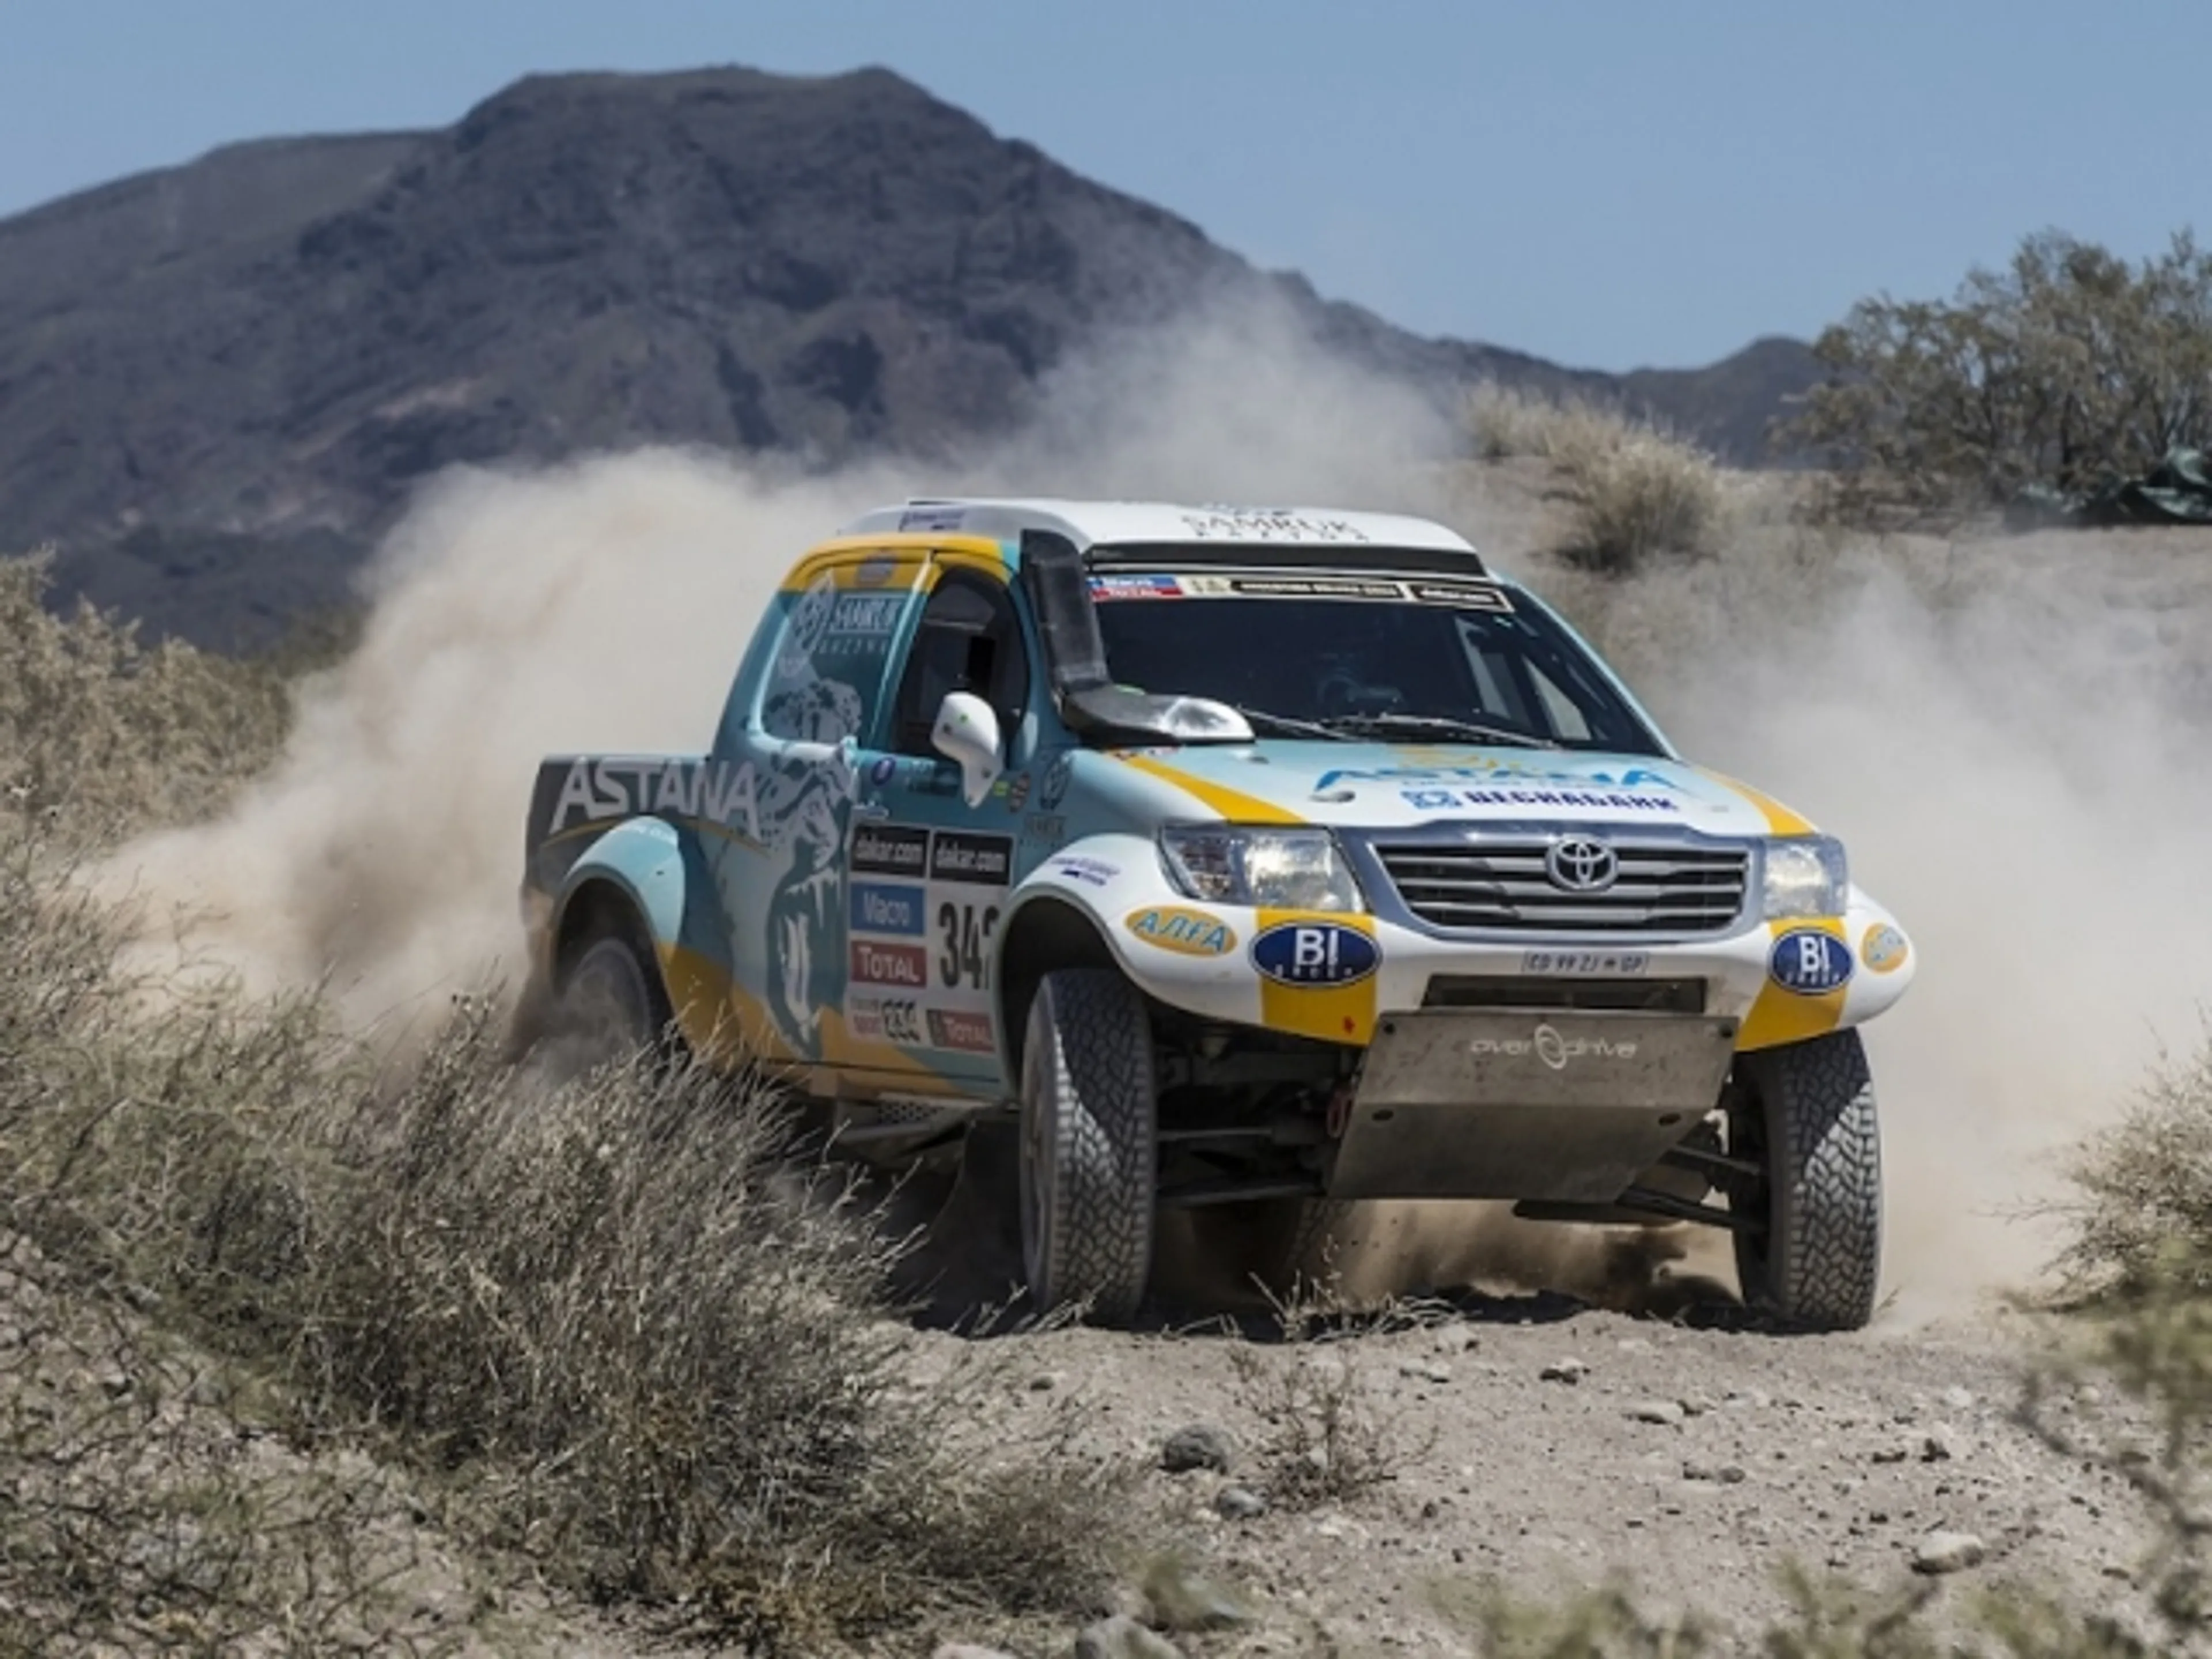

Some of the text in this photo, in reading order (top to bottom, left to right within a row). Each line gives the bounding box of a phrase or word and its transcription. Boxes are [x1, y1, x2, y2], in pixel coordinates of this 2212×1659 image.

[548, 755, 763, 842] ASTANA
[857, 945, 921, 983] TOTAL
[1294, 929, 1339, 966] BI
[1800, 936, 1831, 974] BI
